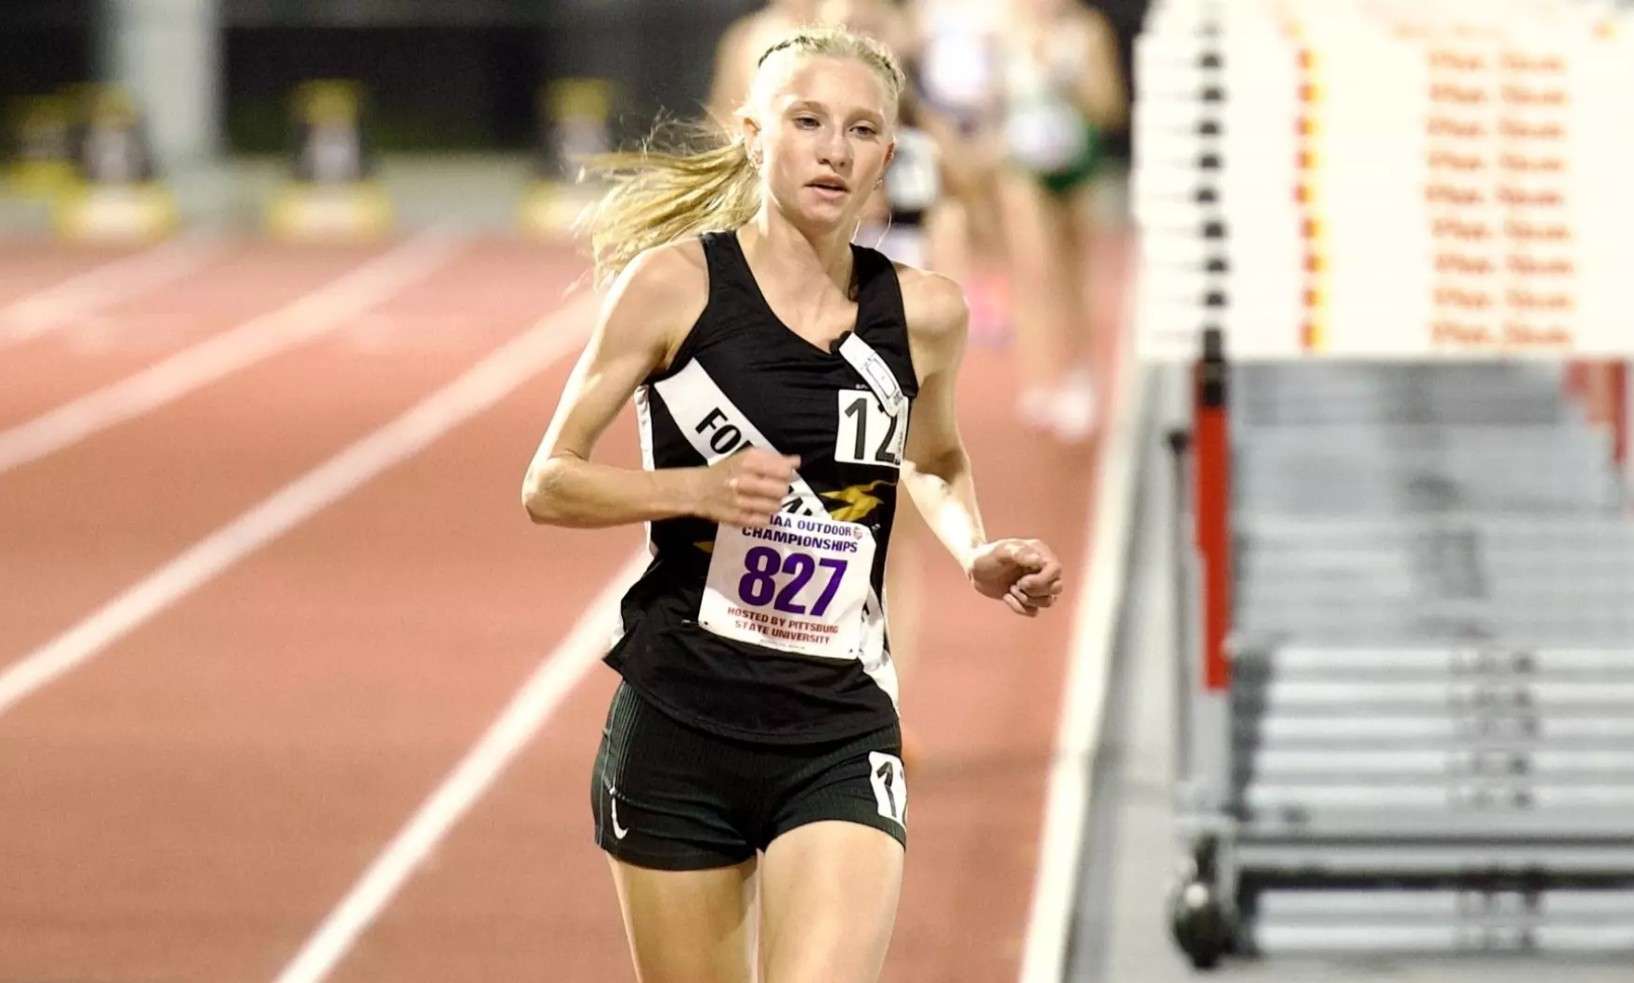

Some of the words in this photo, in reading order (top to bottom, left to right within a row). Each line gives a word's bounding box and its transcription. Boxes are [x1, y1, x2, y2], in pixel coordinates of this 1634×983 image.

[695, 407, 754, 455] FO
[769, 514, 792, 529] IAA
[797, 519, 852, 537] OUTDOOR
[742, 527, 858, 553] CHAMPIONSHIPS
[738, 546, 848, 617] 827
[727, 607, 769, 623] HOSTED
[770, 615, 786, 627] BY
[735, 620, 769, 635] STATE
[771, 628, 830, 645] UNIVERSITY
